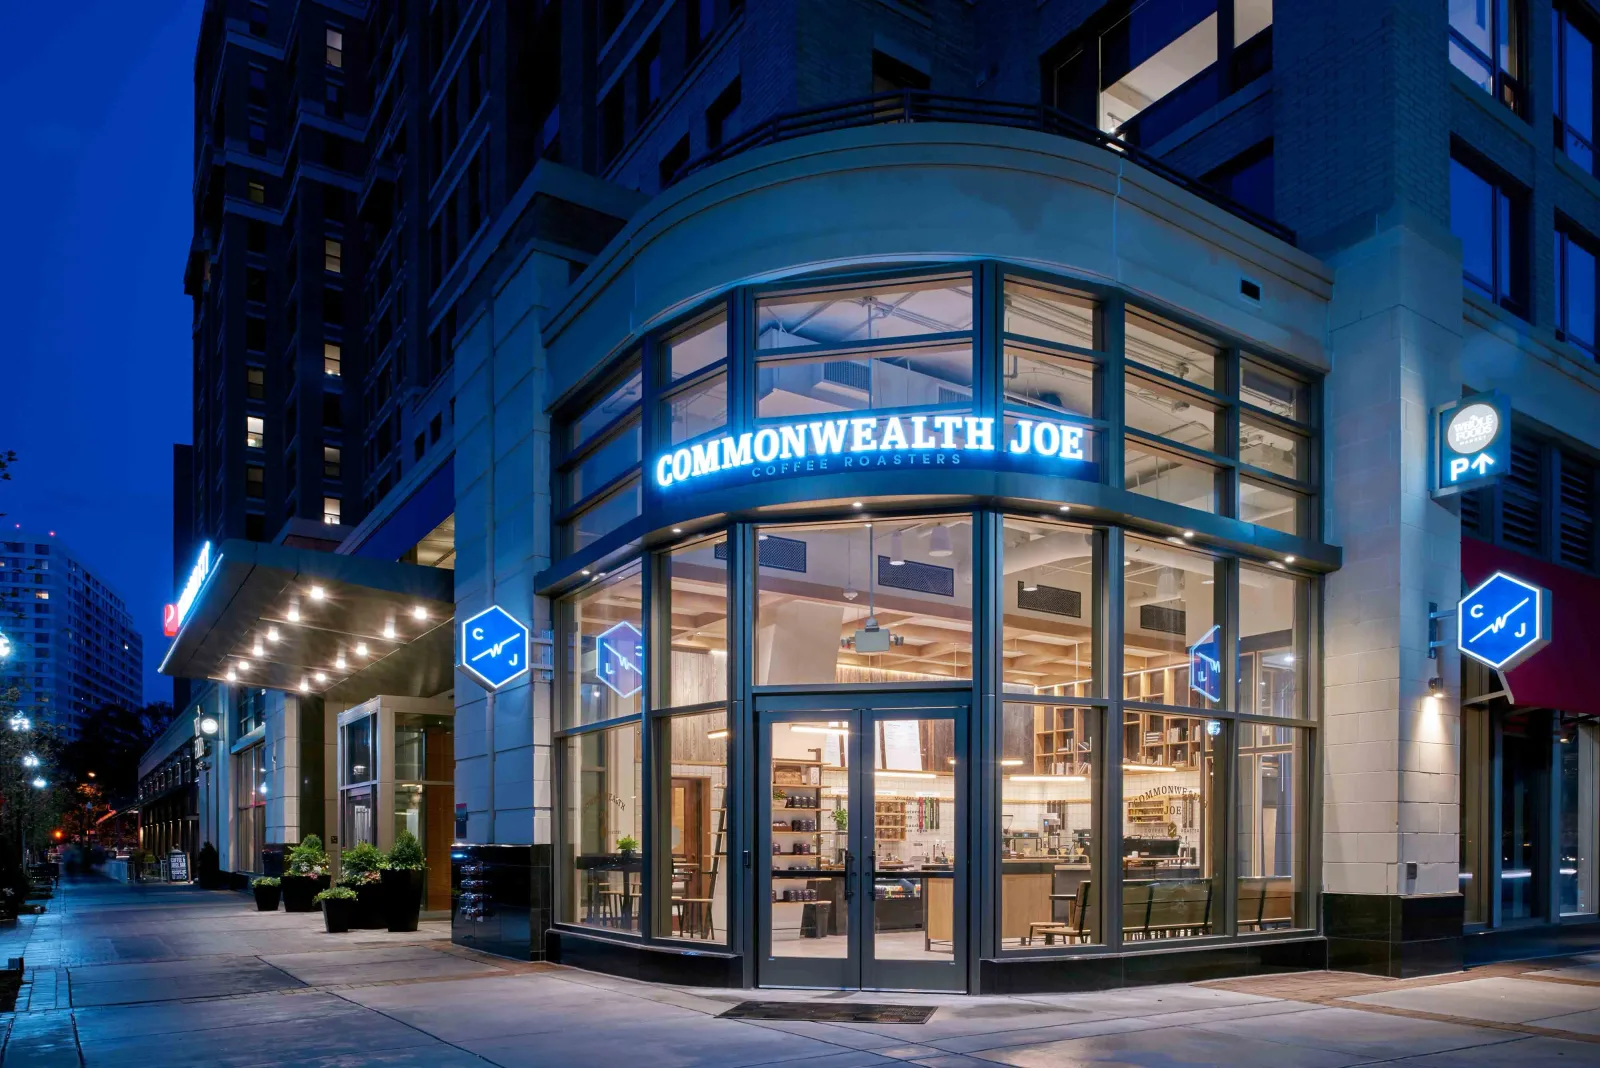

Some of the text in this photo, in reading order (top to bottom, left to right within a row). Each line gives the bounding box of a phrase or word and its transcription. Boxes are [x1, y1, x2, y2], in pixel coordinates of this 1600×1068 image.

[1454, 414, 1493, 433] WHOLE
[1455, 424, 1493, 441] FOODS
[1460, 435, 1487, 446] MARKET
[656, 416, 1083, 486] COMMONWEALTH JOE
[752, 453, 961, 477] COFFEE ROASTERS
[1451, 458, 1469, 481] P
[1470, 604, 1484, 619] C
[472, 628, 484, 641] C
[1514, 622, 1526, 638] J
[508, 653, 518, 666] J
[1164, 806, 1182, 815] JOE
